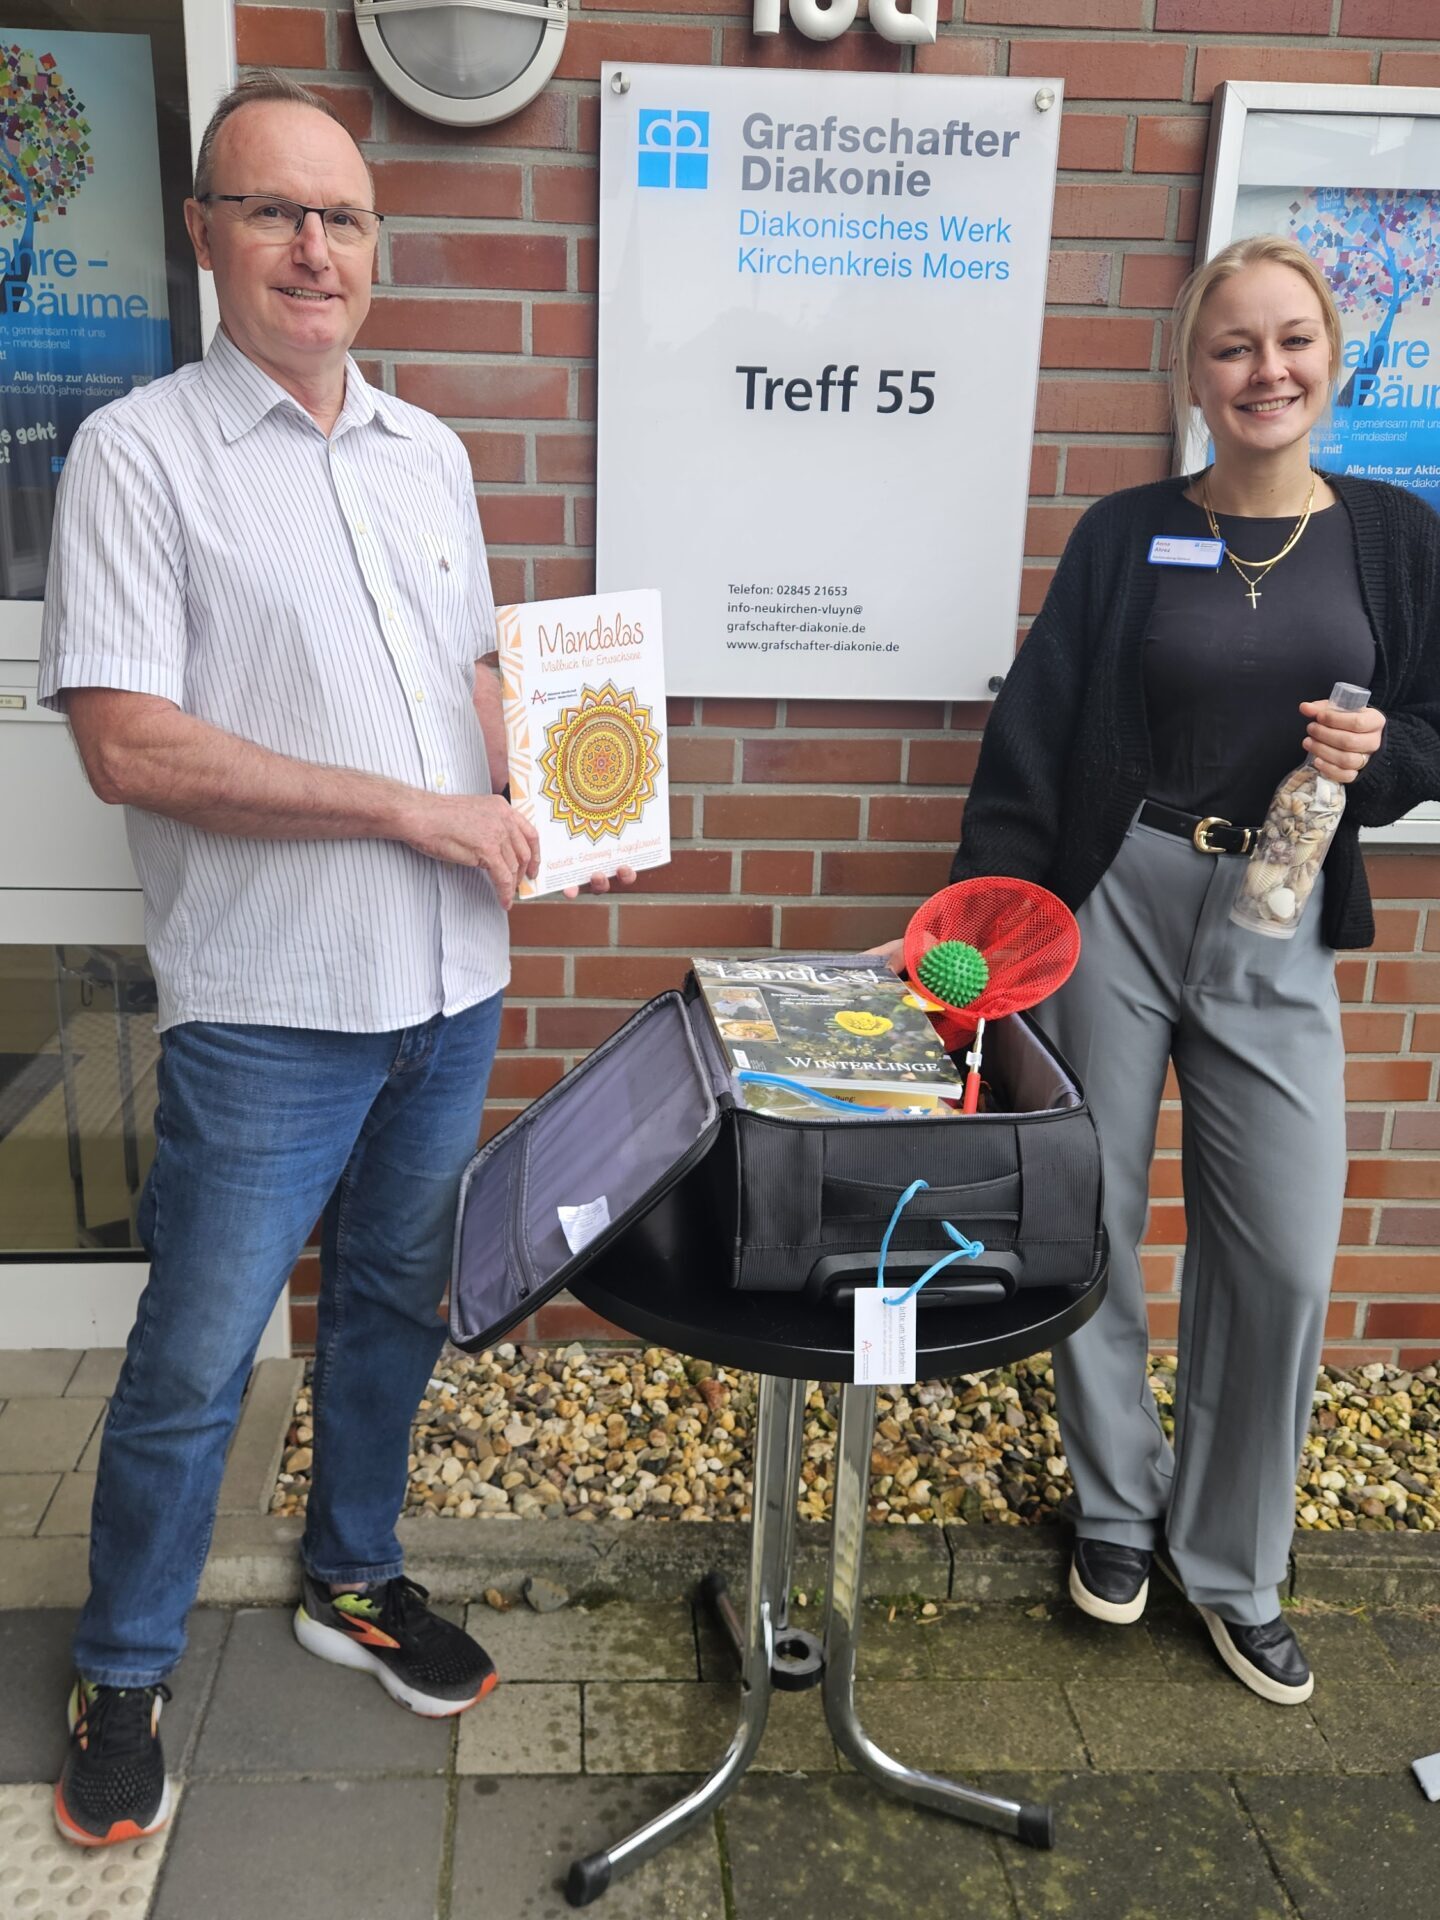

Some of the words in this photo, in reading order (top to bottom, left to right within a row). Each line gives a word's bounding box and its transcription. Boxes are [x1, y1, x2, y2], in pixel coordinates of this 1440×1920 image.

[742, 112, 1020, 158] Grafschafter
[741, 155, 931, 197] Diakonie
[739, 209, 928, 241] Diakonisches
[939, 215, 1012, 243] Werk
[738, 247, 912, 278] Kirchenkreis
[922, 252, 1010, 280] Moers
[5, 281, 148, 318] Bäume
[12, 326, 68, 337] gemeinsam
[71, 327, 85, 337] mit
[14, 371, 33, 381] Alle
[37, 372, 62, 382] Infos
[65, 374, 82, 383] zur
[85, 373, 124, 384] Aktion:
[735, 364, 859, 412] Treff
[876, 370, 936, 414] 55
[1352, 373, 1440, 408] Bäu
[1353, 419, 1408, 430] gemeinsam
[1410, 418, 1425, 428] mit
[16, 421, 57, 445] geht
[1345, 464, 1365, 475] Alle
[1367, 464, 1394, 475] Infos
[1395, 466, 1412, 475] zur
[728, 584, 774, 595] Telefon:
[776, 584, 811, 596] 02845
[814, 585, 848, 597] 21653
[727, 602, 863, 617] info-neukirchen-vluyn@
[538, 612, 644, 657] Mandalas
[727, 620, 866, 634] grafschafter-diakonie.de
[726, 639, 900, 653] www.grafschafter-diakonie.de
[582, 655, 594, 667] für
[786, 1056, 941, 1073] WINTERLINGE
